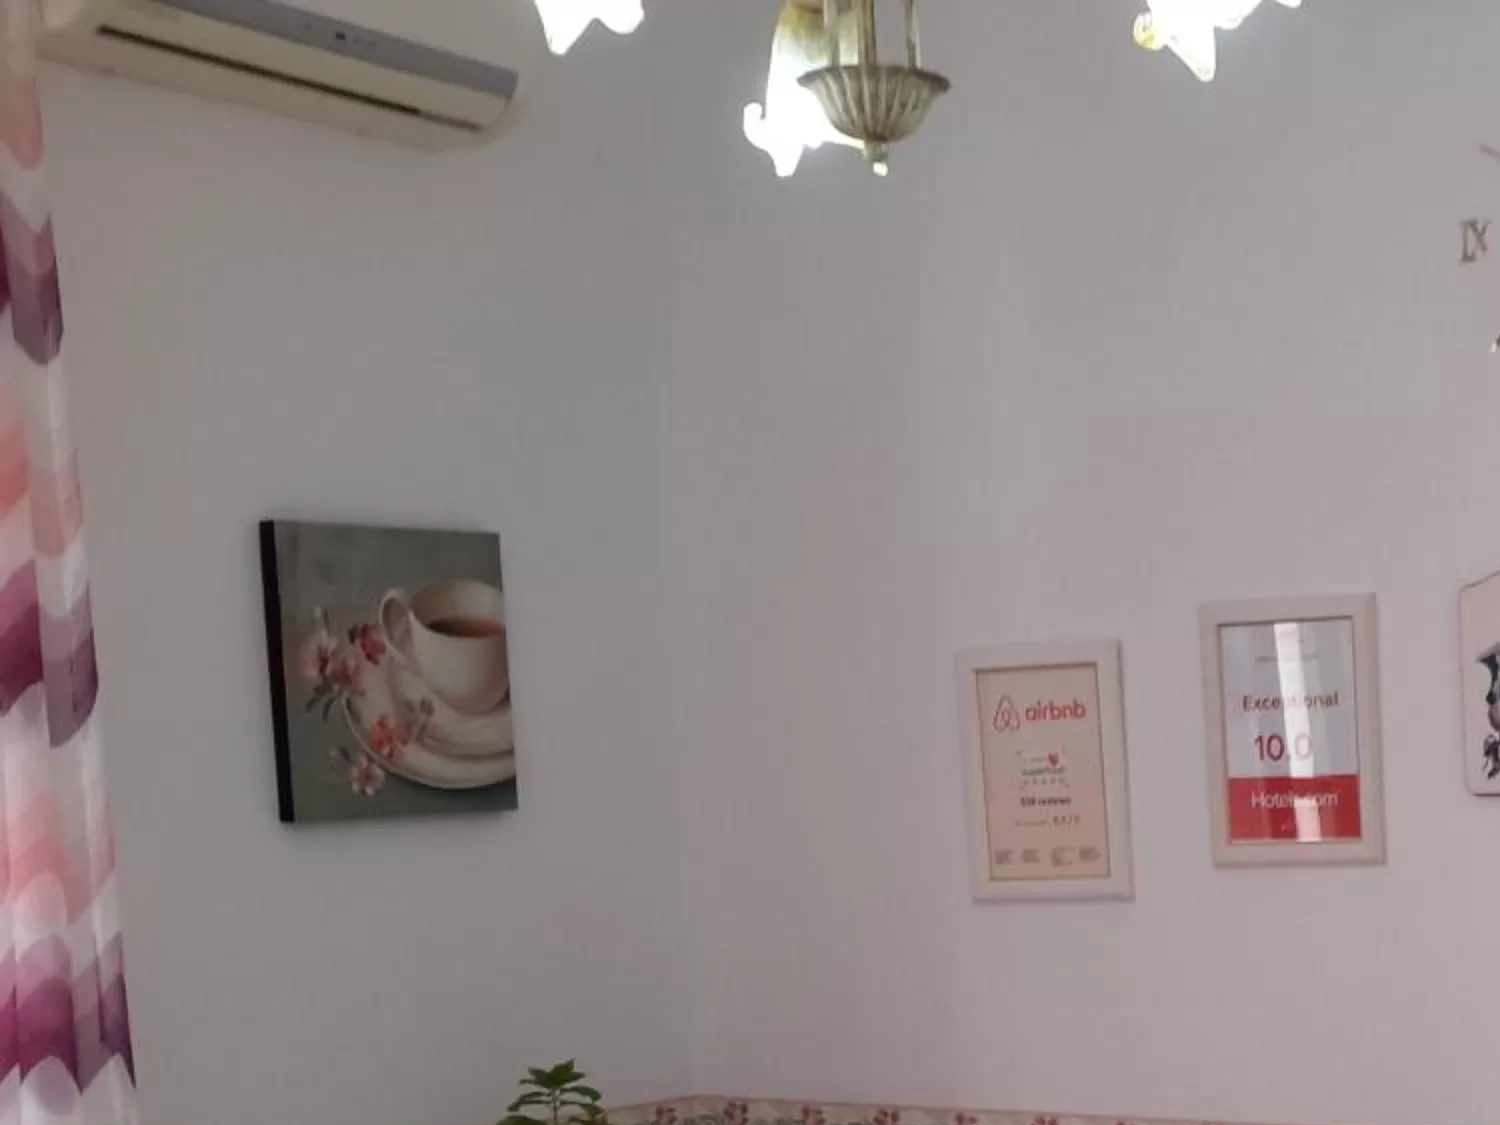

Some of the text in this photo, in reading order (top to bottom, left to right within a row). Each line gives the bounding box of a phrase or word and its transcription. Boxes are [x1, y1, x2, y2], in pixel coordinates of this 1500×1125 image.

[1025, 698, 1087, 721] airbnb
[1243, 690, 1338, 712] Exceonal
[1254, 733, 1312, 761] 100
[1251, 790, 1338, 808] Hotelom
